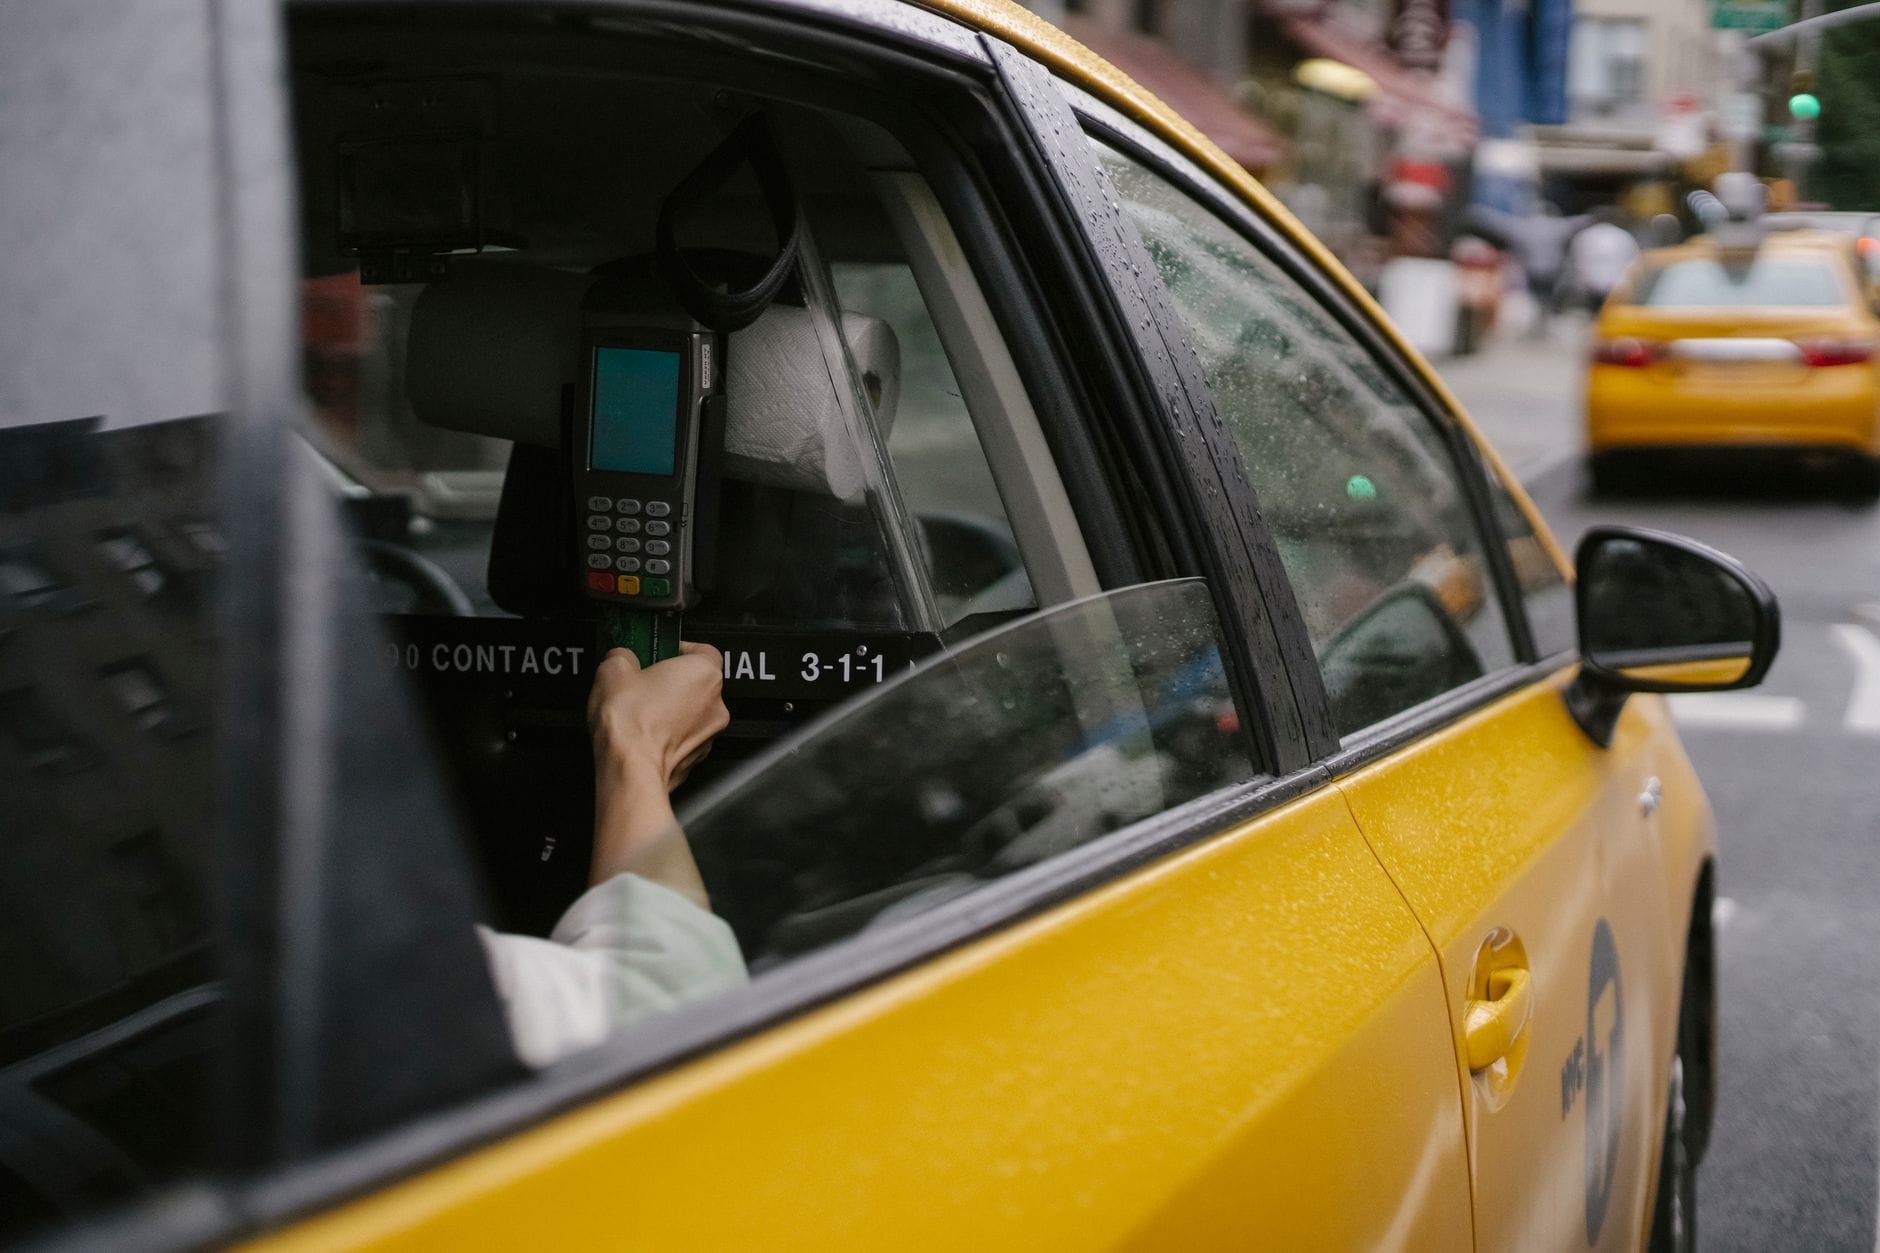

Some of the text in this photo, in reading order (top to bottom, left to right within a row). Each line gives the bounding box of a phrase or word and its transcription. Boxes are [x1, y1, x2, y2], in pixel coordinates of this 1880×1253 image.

[431, 643, 585, 675] CONTACT
[724, 650, 776, 681] IAL
[801, 652, 883, 683] 3-1-1
